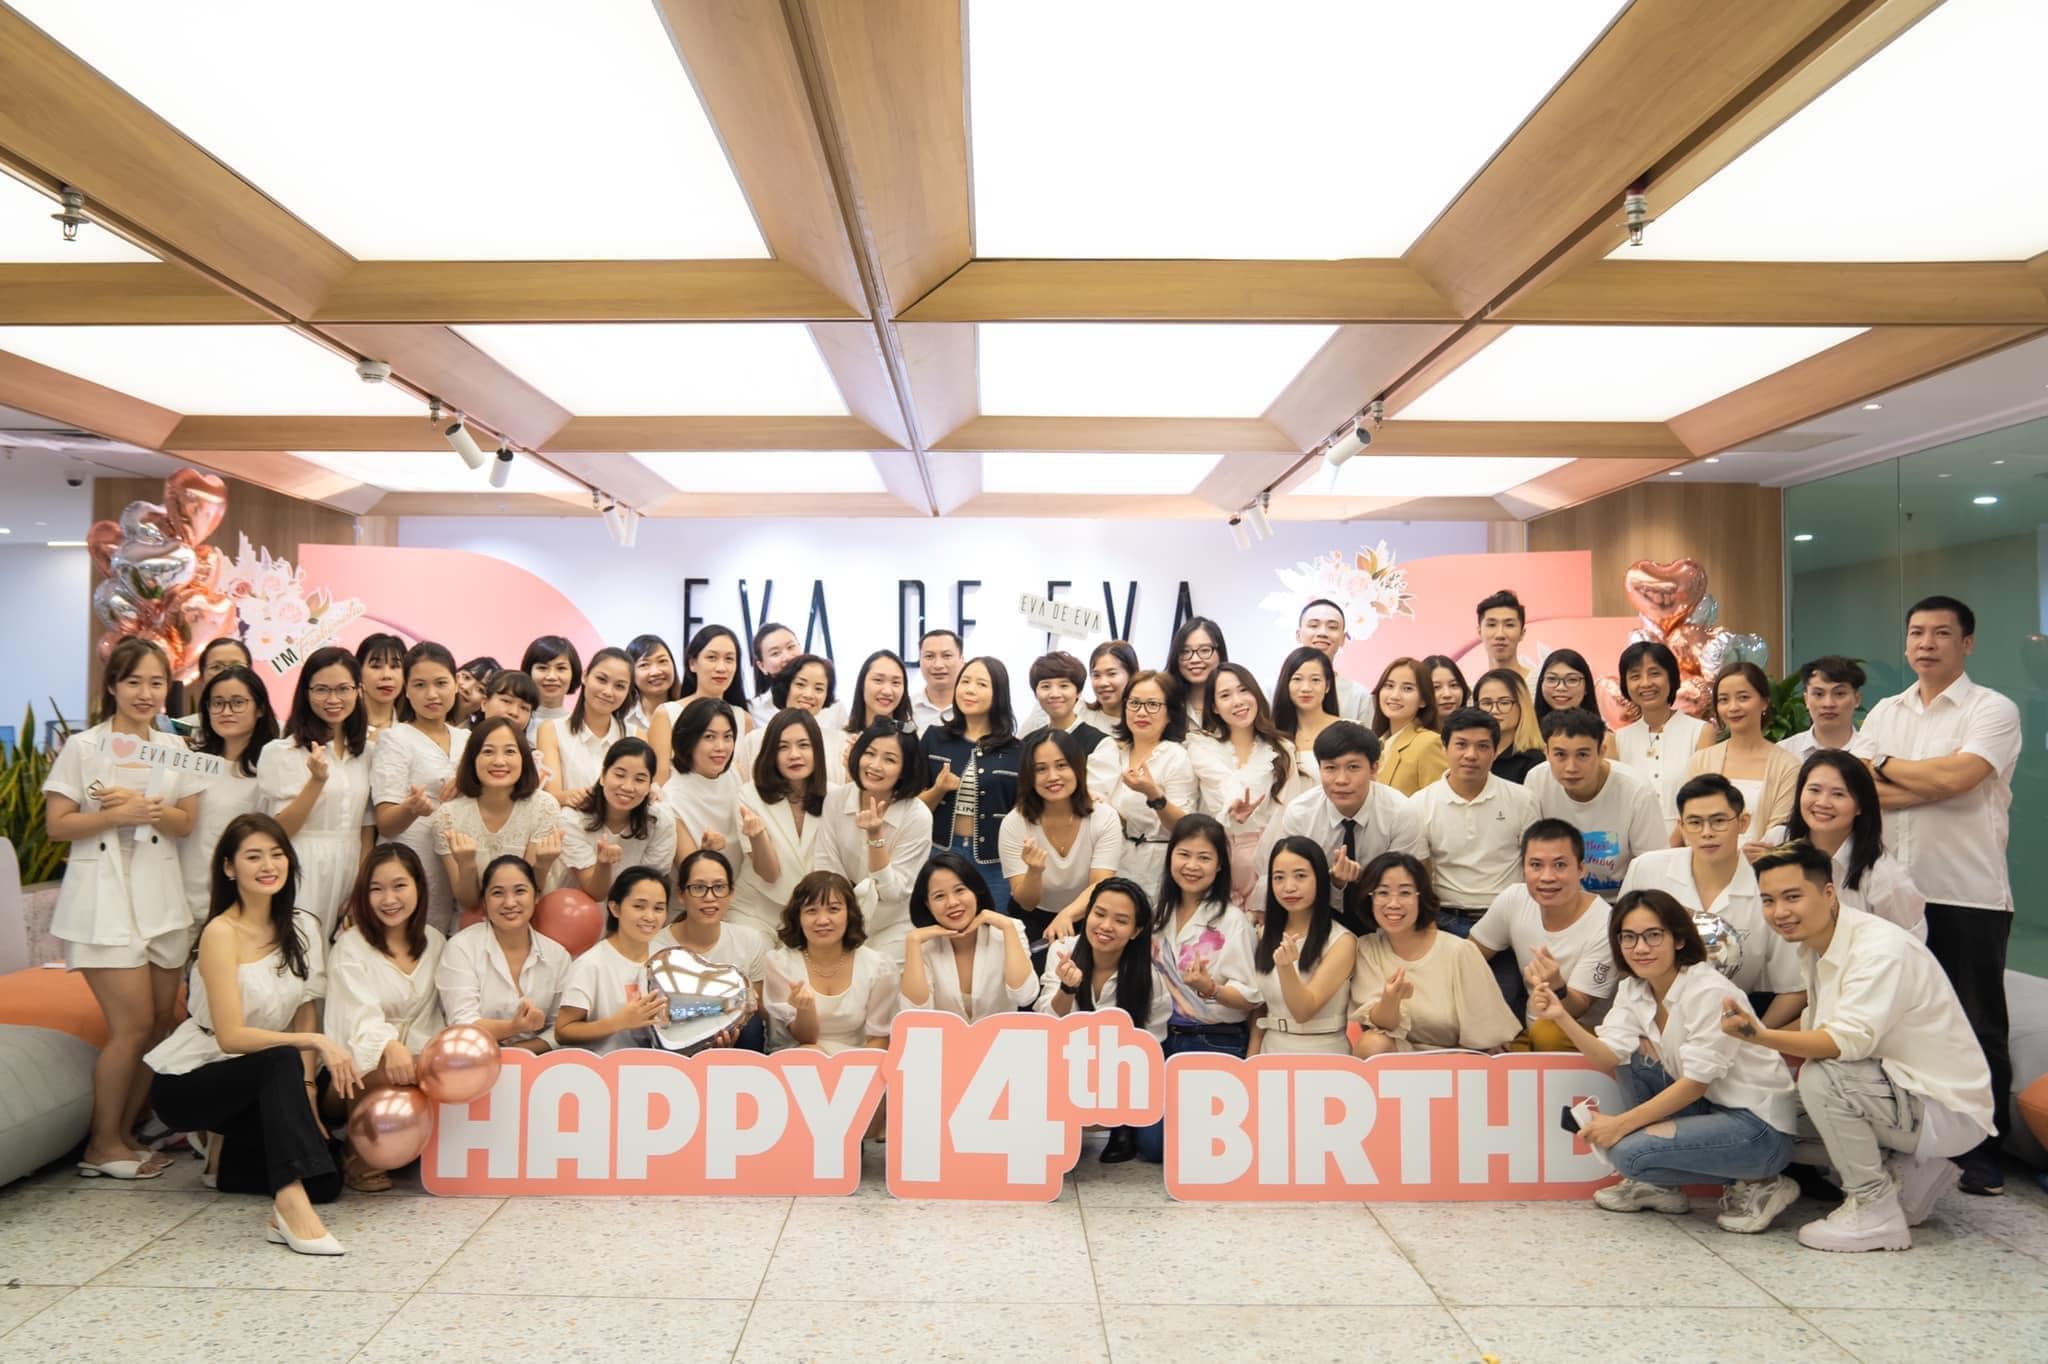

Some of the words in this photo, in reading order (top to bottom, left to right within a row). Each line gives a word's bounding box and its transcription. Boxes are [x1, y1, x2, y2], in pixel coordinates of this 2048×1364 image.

[898, 579, 982, 669] DE
[1020, 595, 1045, 617] EVA
[1052, 603, 1069, 622] DE
[1074, 608, 1099, 630] EVA
[271, 648, 299, 673] I'M
[139, 745, 166, 764] EVA
[172, 752, 190, 768] DE
[194, 756, 220, 775] EVA
[436, 1063, 877, 1180] HAPPY
[897, 1024, 1149, 1184] 14th
